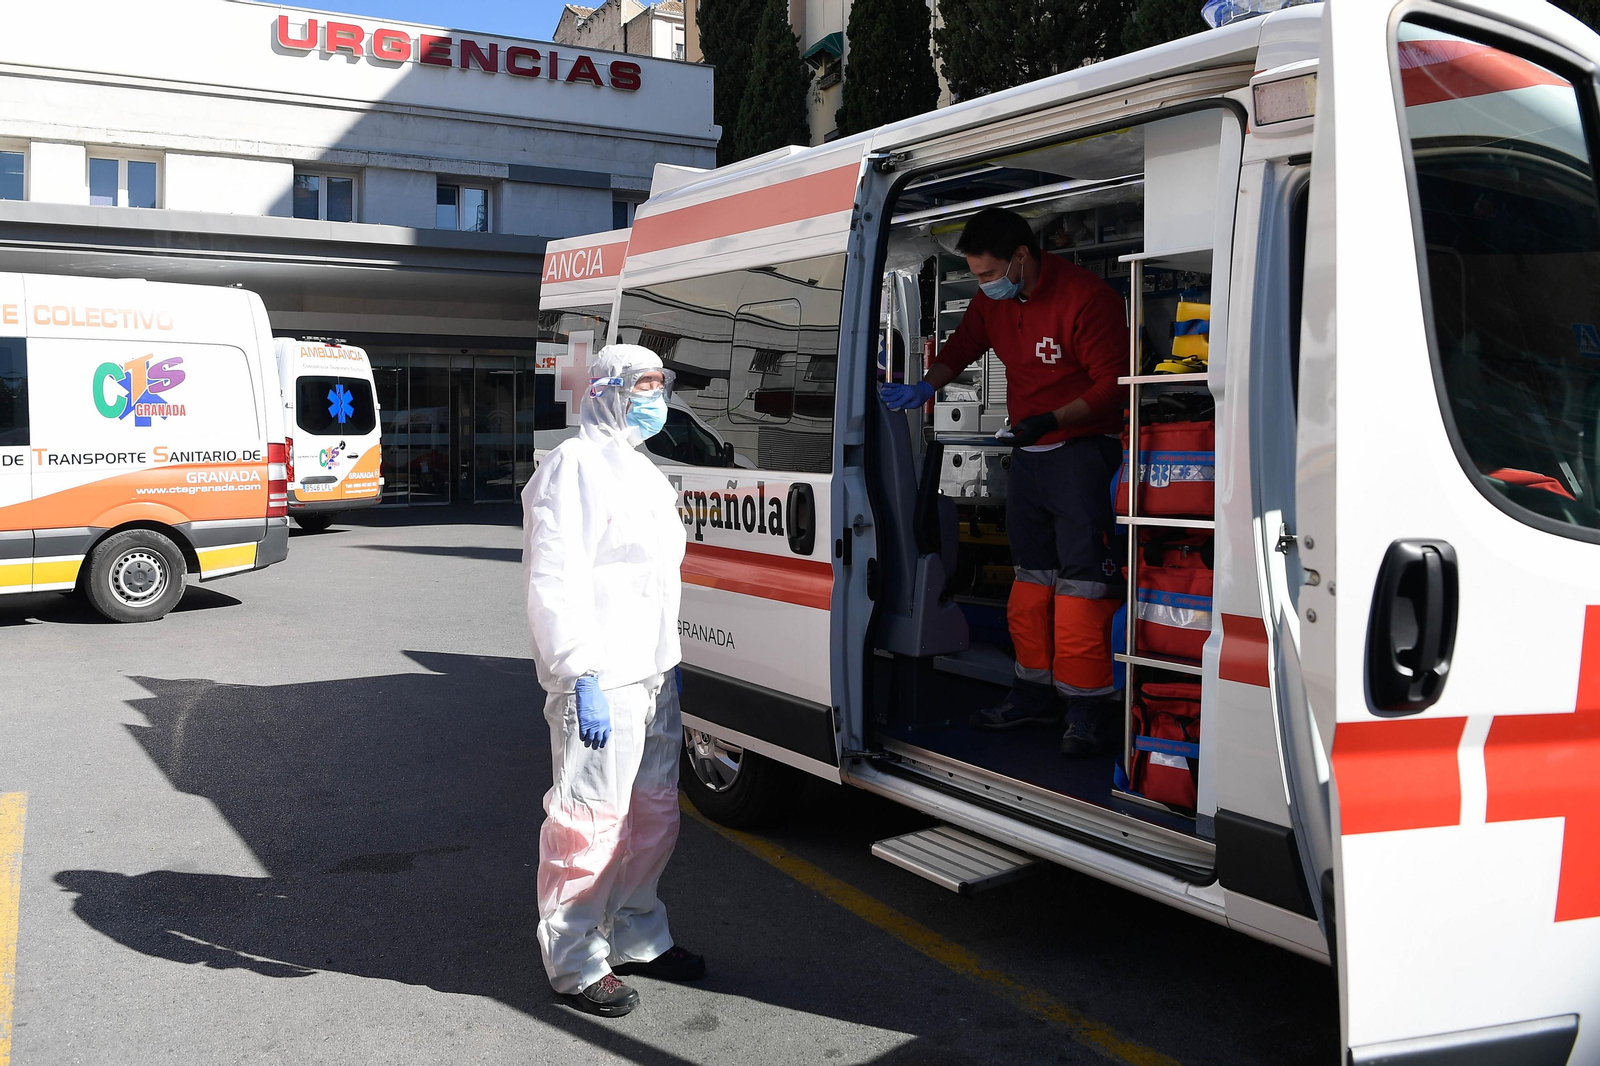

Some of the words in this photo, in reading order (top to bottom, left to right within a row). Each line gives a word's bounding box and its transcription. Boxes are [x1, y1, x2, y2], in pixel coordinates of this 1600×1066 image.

[277, 14, 642, 92] URGENCIAS
[541, 247, 604, 282] ANCIA
[33, 304, 174, 331] COLECTIVO
[300, 346, 364, 362] AMBULANCIA
[92, 353, 186, 419] CTS
[136, 403, 187, 417] GRANADA
[2, 454, 24, 467] DE
[32, 448, 147, 466] TRANSPORTE
[153, 446, 237, 464] SANITARIO
[242, 450, 261, 462] DE
[186, 470, 261, 484] GRANADA
[348, 471, 375, 479] GRANADA
[136, 484, 261, 494] www.ctsgranada.com
